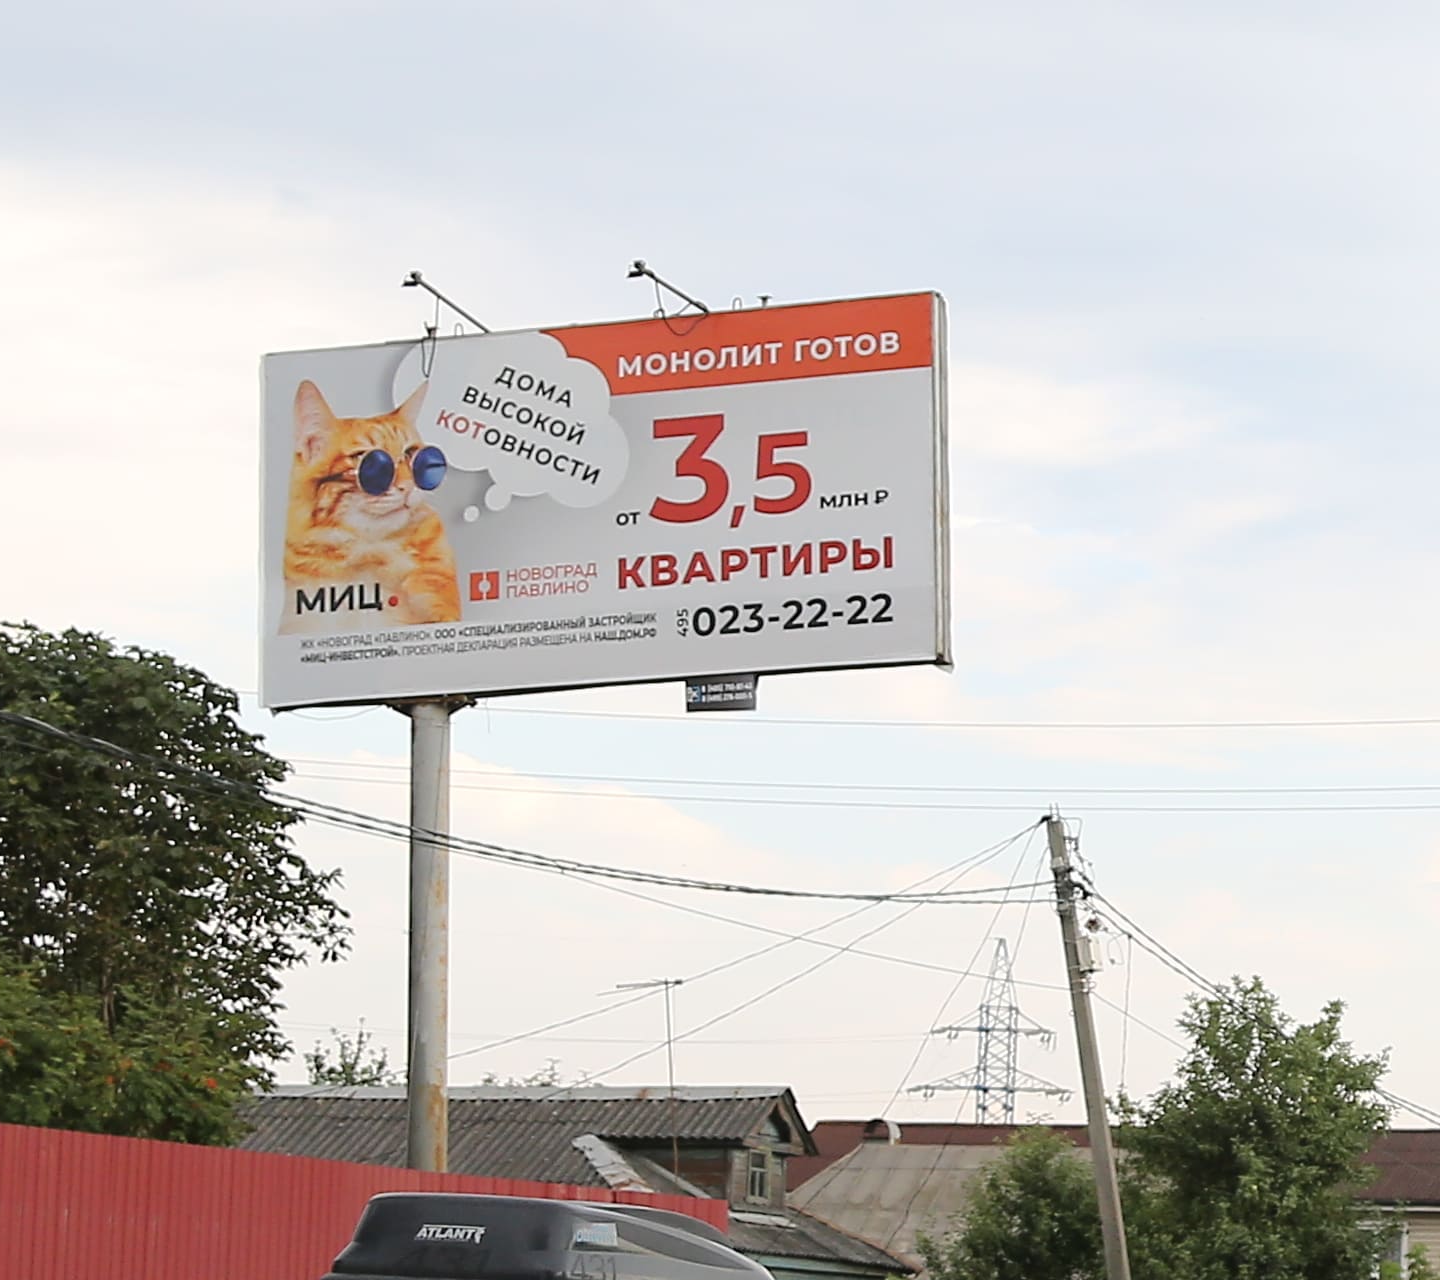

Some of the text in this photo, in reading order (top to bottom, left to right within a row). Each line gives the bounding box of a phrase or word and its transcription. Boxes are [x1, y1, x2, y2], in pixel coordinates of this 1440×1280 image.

[618, 331, 901, 378] МОНОЛИТ ГОТОВ
[495, 366, 571, 408] ДОМА
[462, 386, 585, 446] ВЫСОКОЙ
[436, 409, 601, 485] КОТОВНОСТИ
[649, 413, 812, 529] 3,5
[506, 562, 598, 583] НОВОГРАД
[618, 536, 893, 589] КВАРТИРЫ
[506, 579, 590, 599] ПАВЛИНО
[588, 612, 657, 628] ЗАСТРОЙЩИК
[676, 608, 689, 637] 495
[692, 593, 894, 637] 023-22-22
[578, 631, 594, 644] НА
